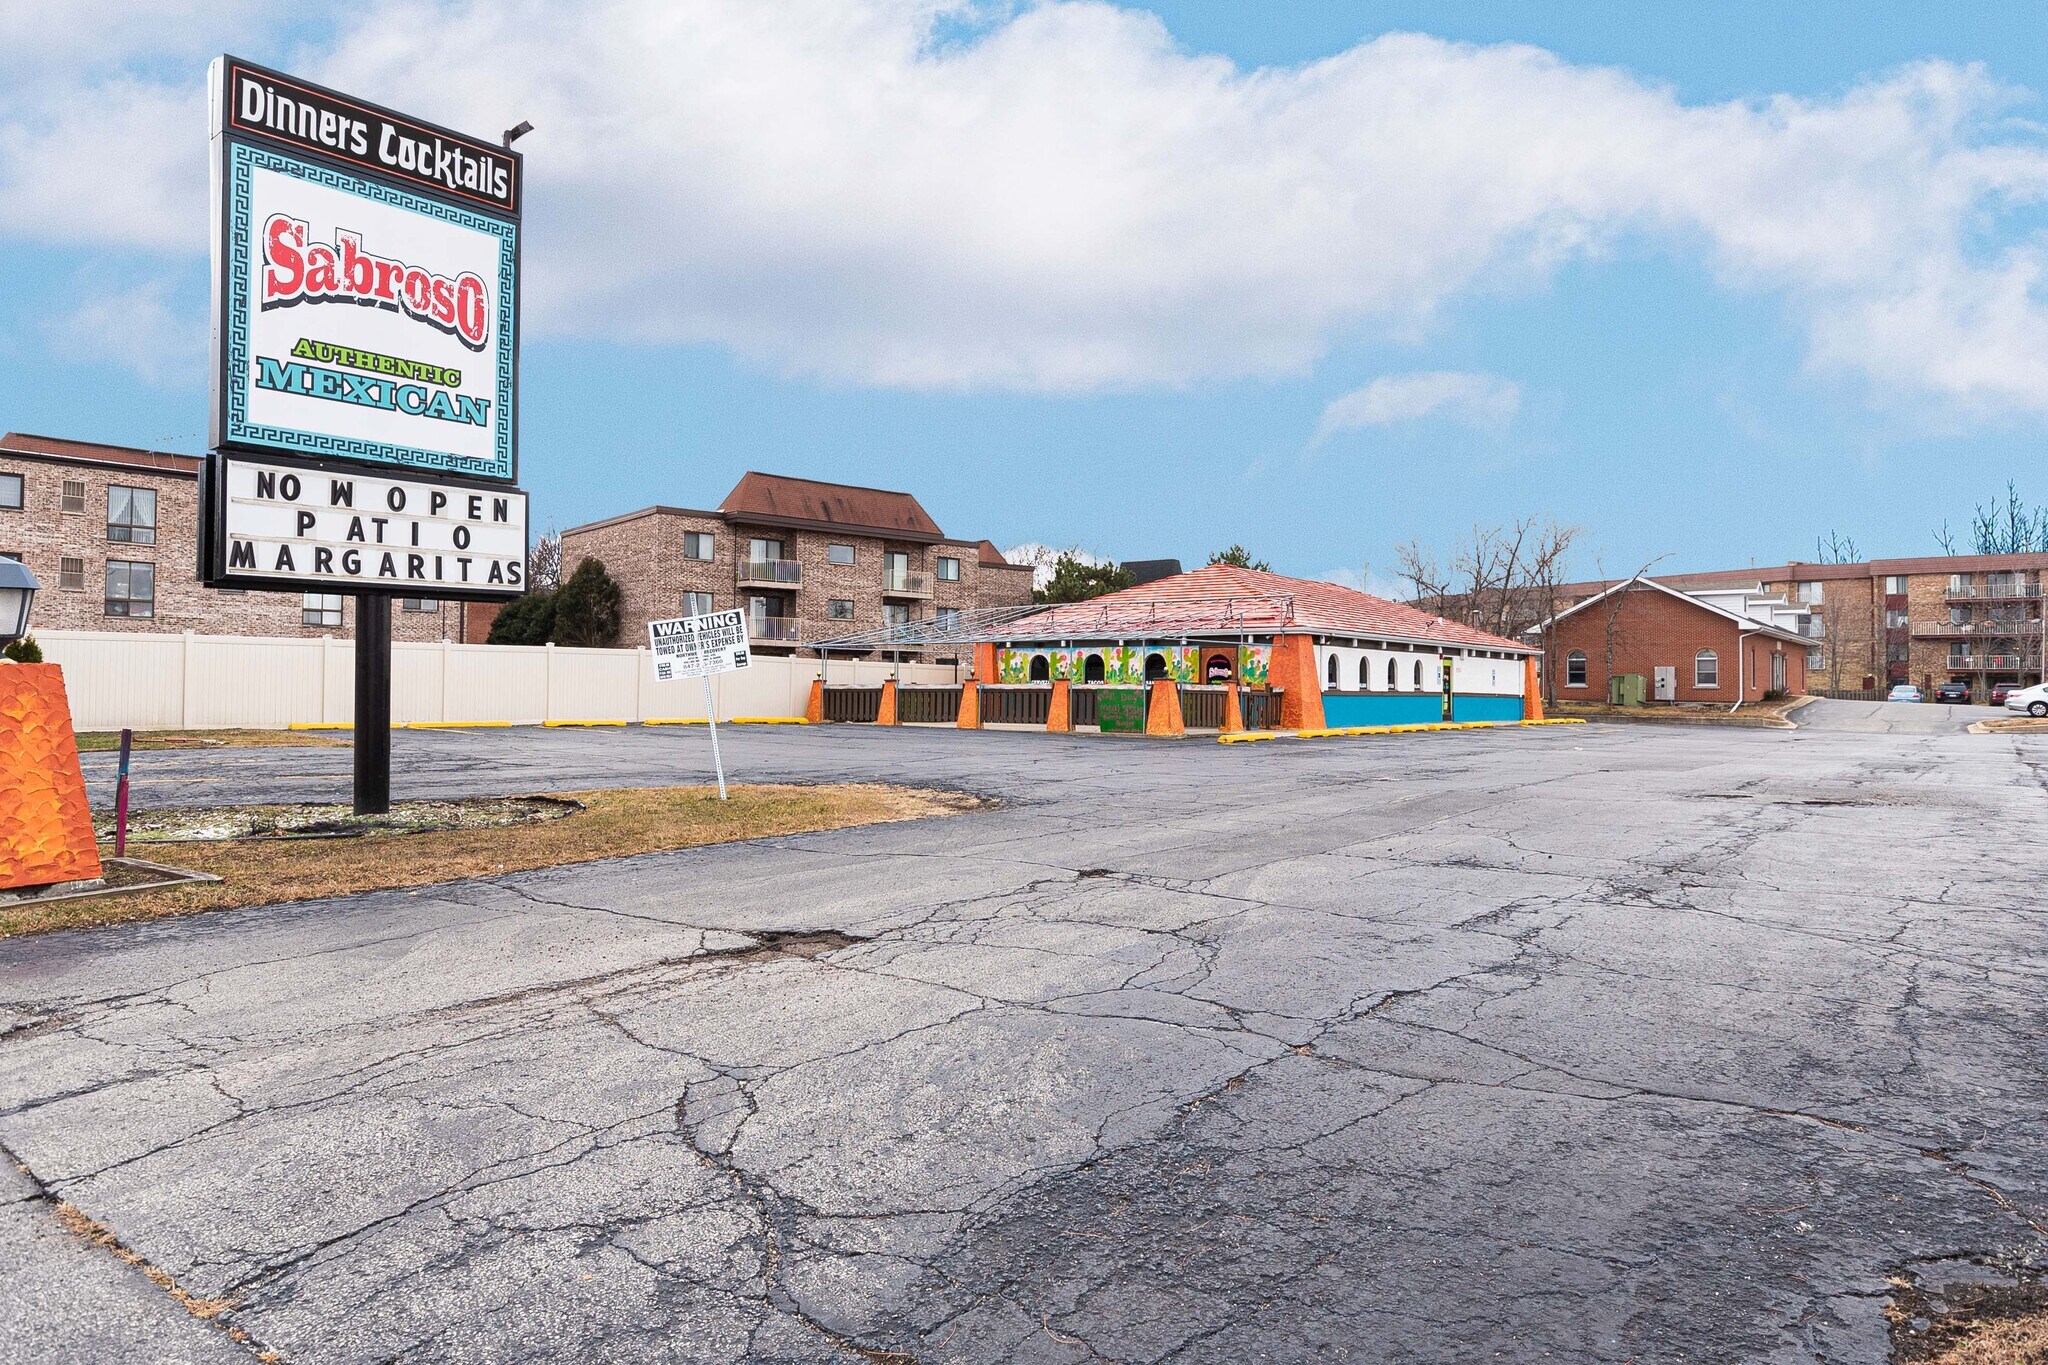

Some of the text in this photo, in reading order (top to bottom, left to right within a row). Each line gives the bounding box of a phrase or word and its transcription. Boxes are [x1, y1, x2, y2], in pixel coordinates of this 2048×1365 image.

[240, 78, 508, 199] Dinners Cocktails
[291, 338, 461, 388] AUTHENTIC
[256, 356, 491, 428] MEXICAN
[387, 486, 508, 523] OPEN
[297, 510, 471, 550] PATIO
[228, 540, 522, 586] MARGARITAS
[654, 633, 695, 647] UNAUTHORIZED
[721, 627, 735, 637] WILL
[735, 625, 743, 635] BE
[656, 612, 738, 637] WARNING
[655, 645, 675, 656] TOWED
[676, 644, 684, 653] AT
[711, 636, 735, 648] EXPENSE
[736, 634, 744, 644] BY
[703, 646, 726, 654] RECOVERY
